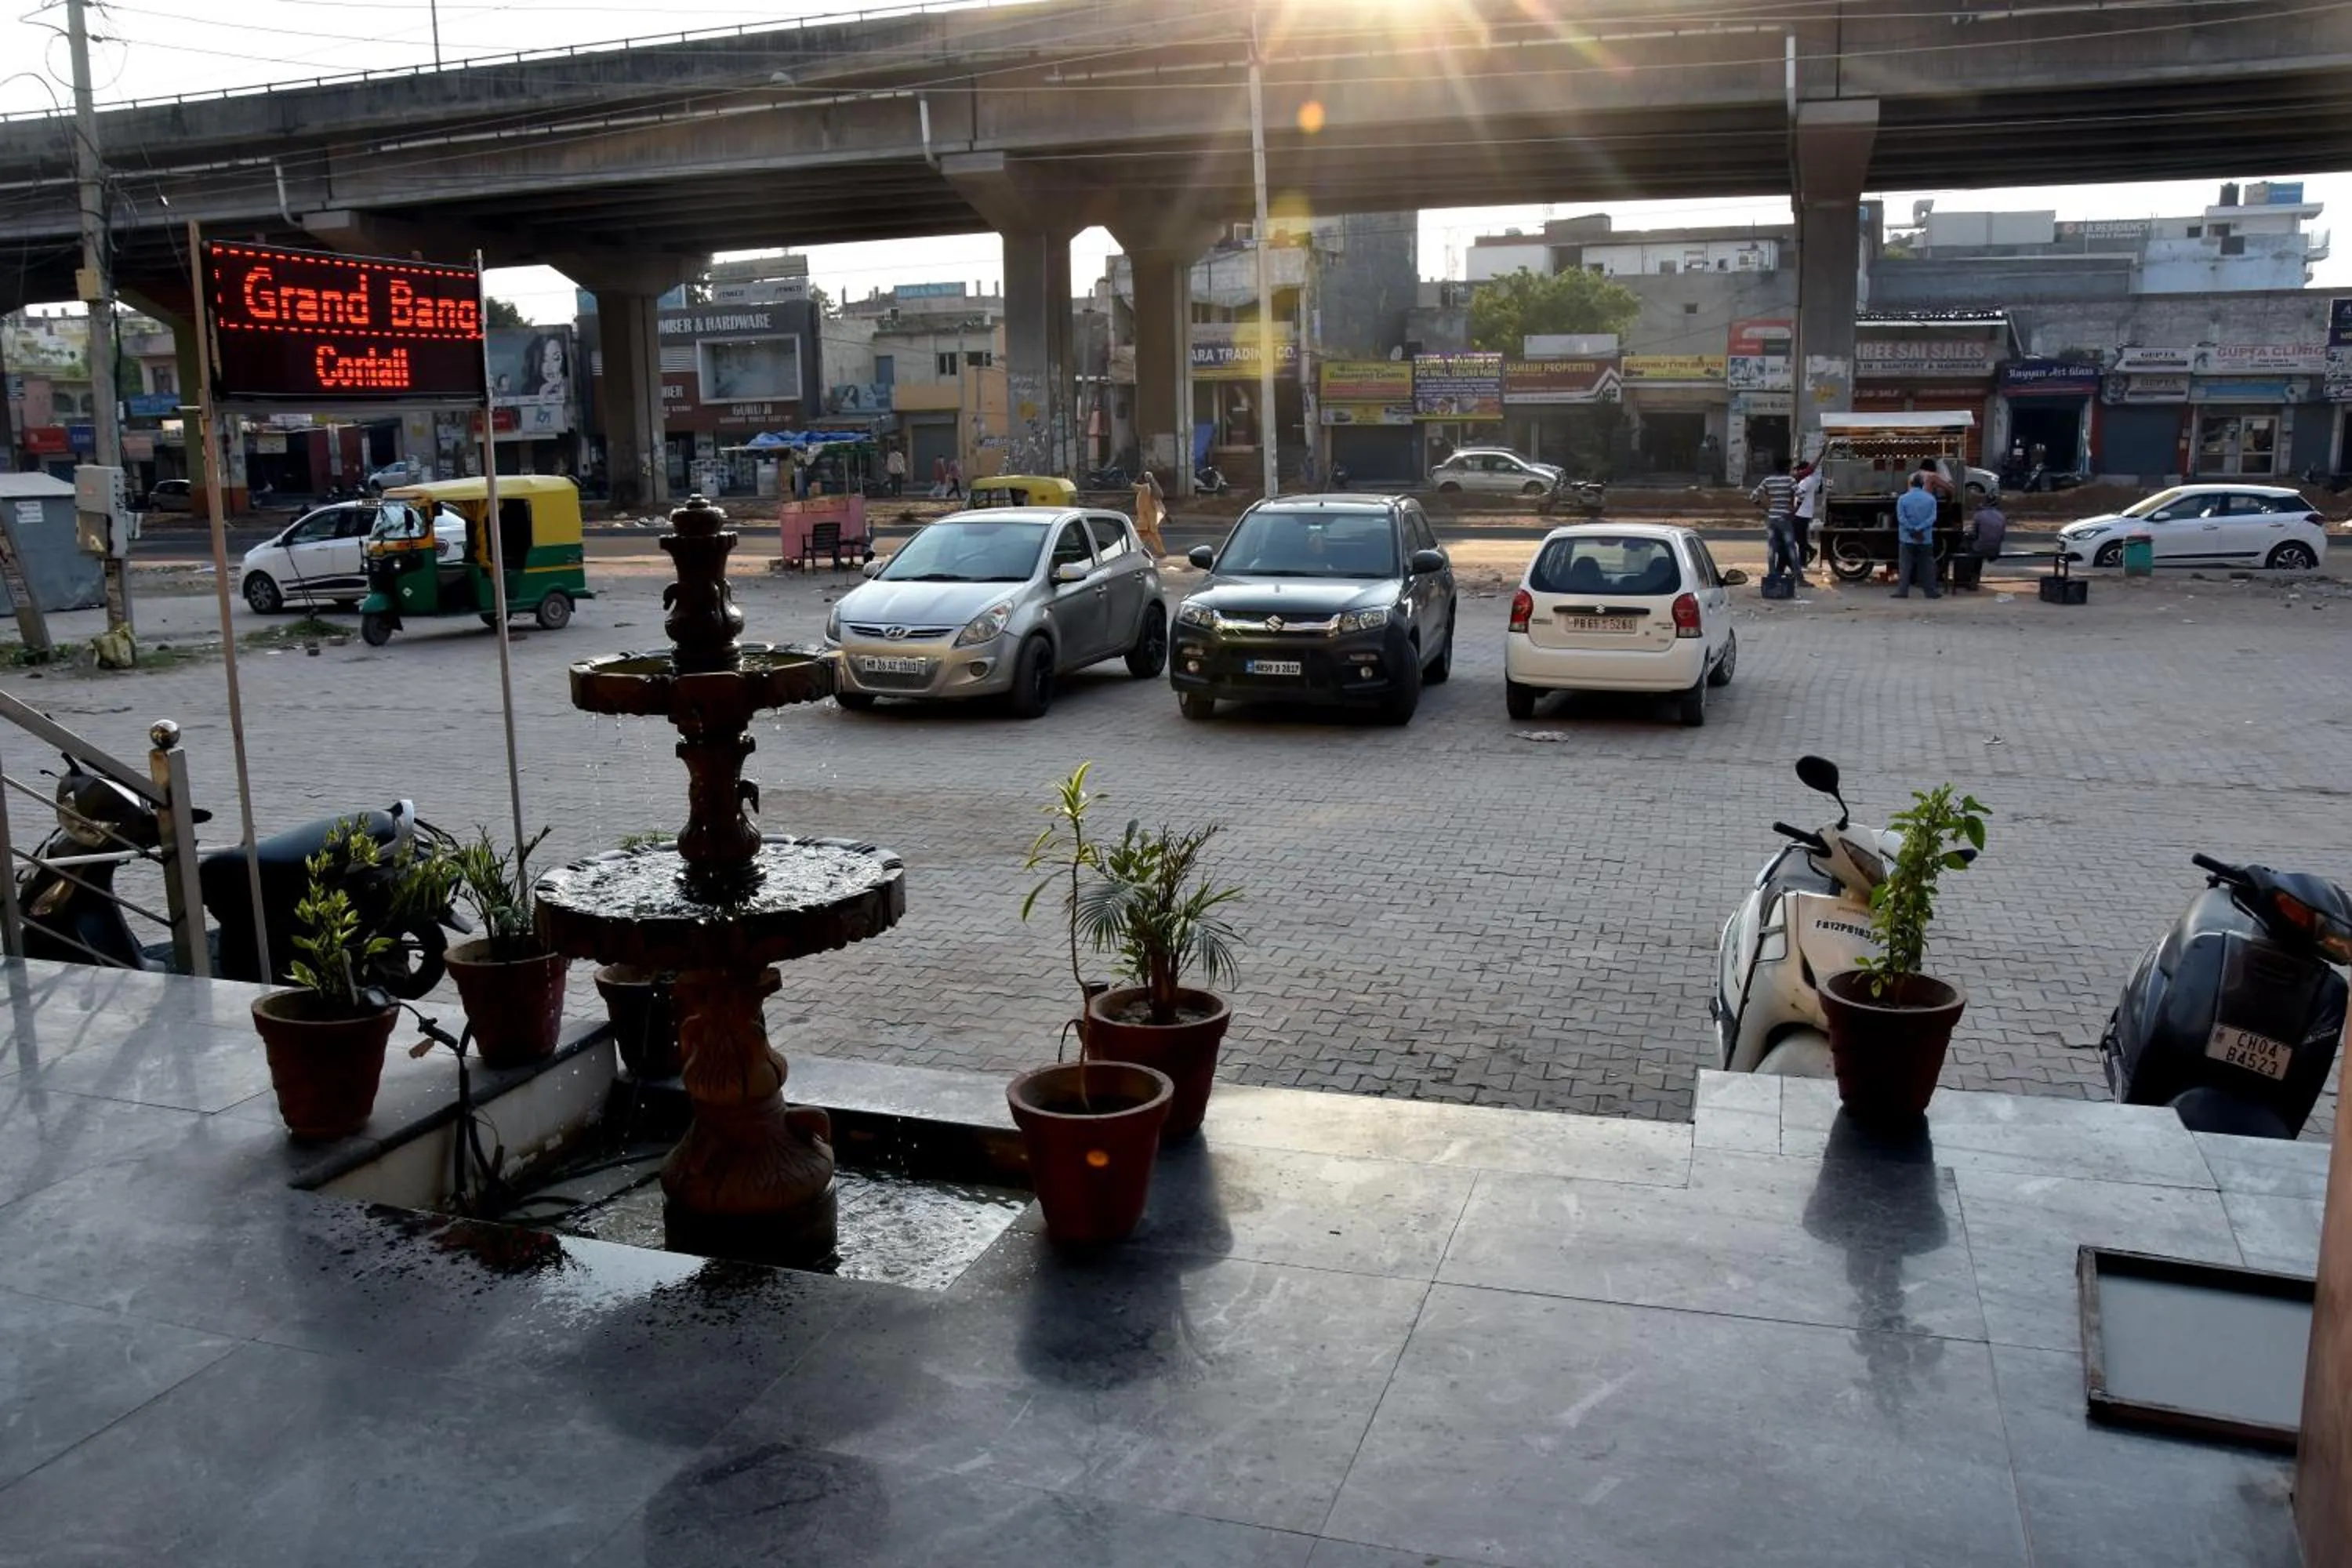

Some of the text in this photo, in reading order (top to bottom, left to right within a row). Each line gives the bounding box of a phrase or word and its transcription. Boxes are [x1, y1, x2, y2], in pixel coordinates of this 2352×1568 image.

[244, 267, 369, 325] Grand
[706, 314, 771, 330] HARDWARE
[1218, 347, 1262, 361] TRADIN
[1896, 343, 1927, 359] SAI
[1931, 343, 1986, 358] SALES
[2237, 1033, 2278, 1057] CH04
